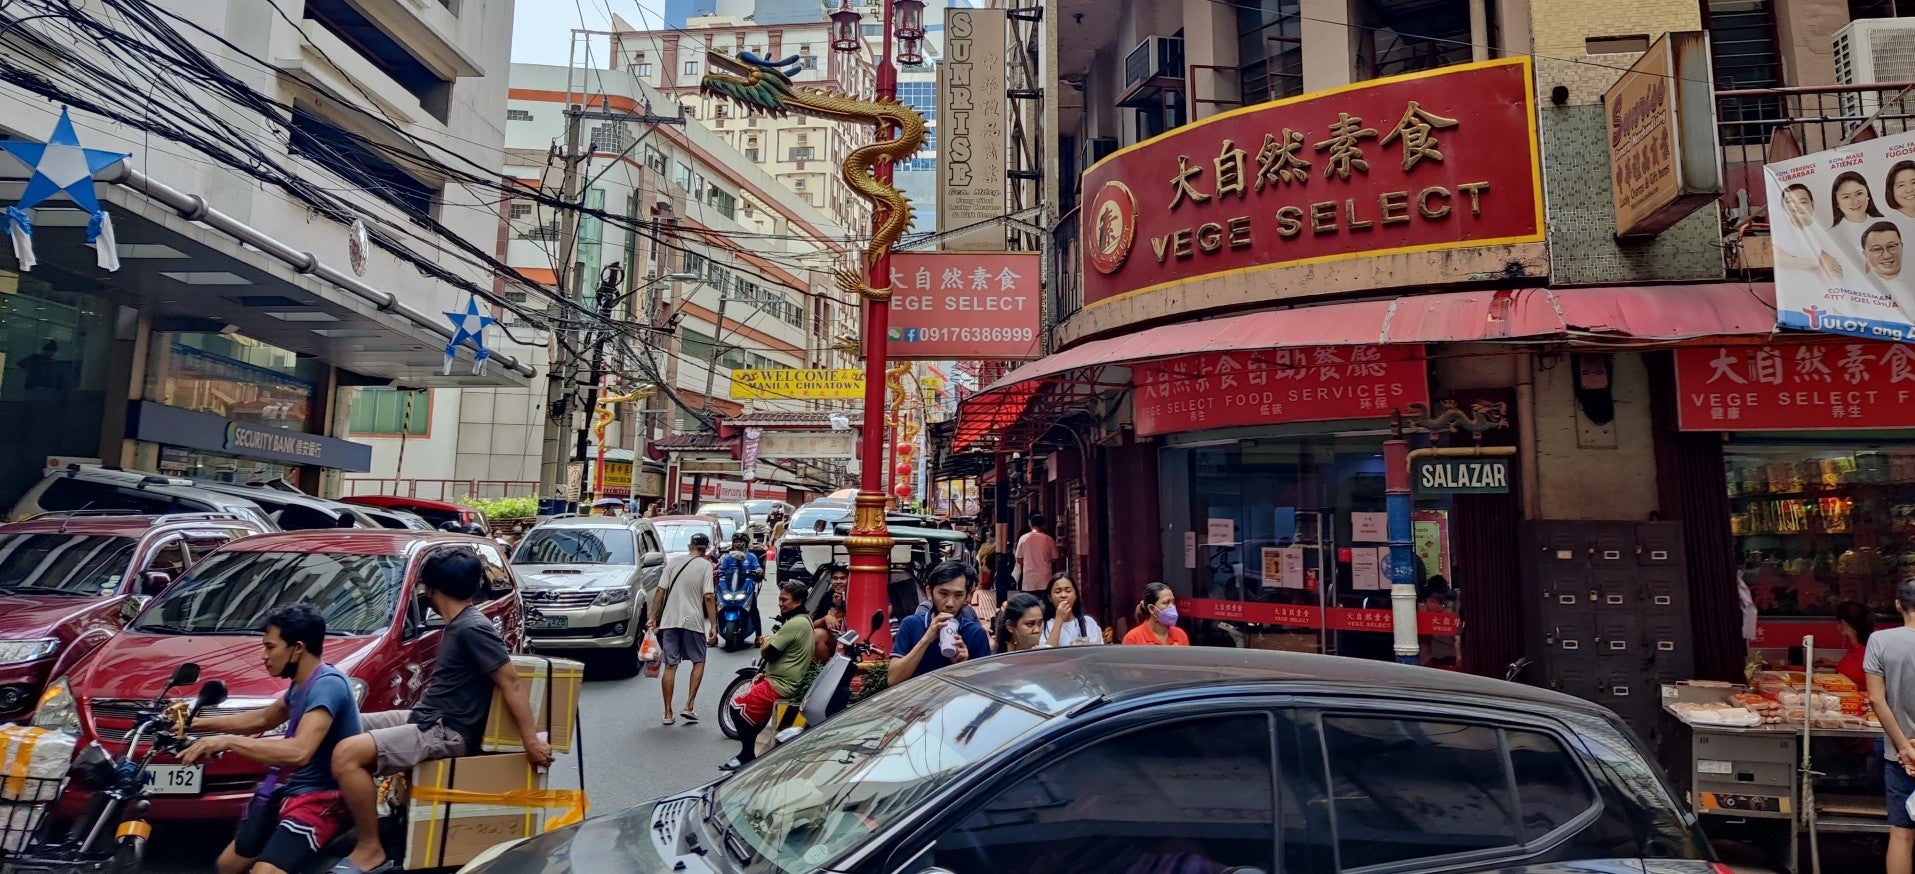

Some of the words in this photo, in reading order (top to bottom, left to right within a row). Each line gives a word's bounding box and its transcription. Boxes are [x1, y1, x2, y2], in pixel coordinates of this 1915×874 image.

[949, 12, 973, 186] SUNRISE
[1168, 101, 1459, 209] 大自然素食
[1830, 158, 1864, 170] ATIENZA
[1151, 216, 1252, 263] VEGE
[1276, 181, 1490, 237] SELECT
[889, 266, 1022, 291] 大自然素食
[1828, 288, 1892, 300] CONGRESSMAN
[891, 296, 933, 311] EGE
[945, 296, 1027, 311] SELECT
[1872, 300, 1899, 308] CHUA
[919, 327, 1033, 342] 09176386999
[1872, 326, 1903, 340] ang
[761, 371, 838, 381] WELCOME
[1168, 397, 1214, 414] SELECT
[1226, 391, 1273, 406] FOOD
[1288, 383, 1403, 402] SERVICES
[1691, 393, 1758, 407] VEGE
[1779, 391, 1879, 405] SELECT
[235, 428, 274, 450] SECURITY
[273, 435, 296, 454] BANK
[1422, 463, 1507, 488] SALAZAR
[168, 770, 194, 786] 152
